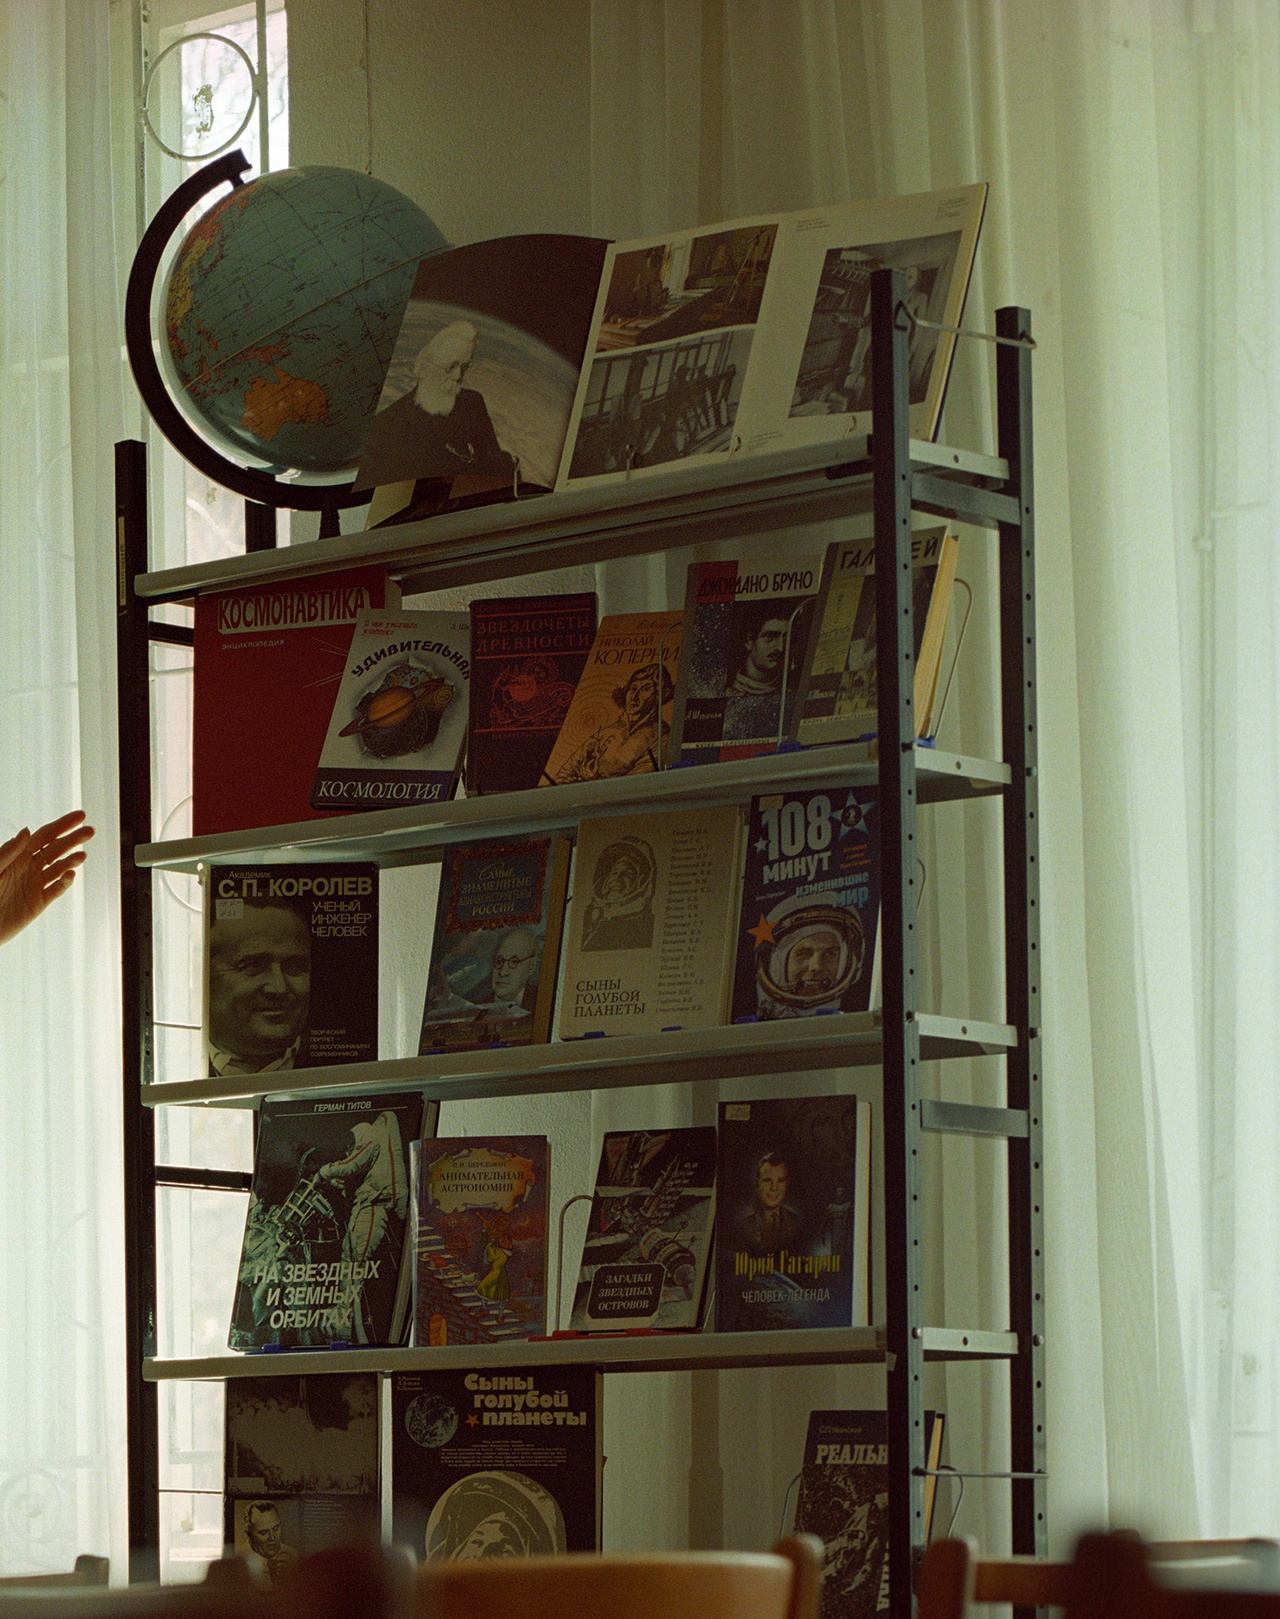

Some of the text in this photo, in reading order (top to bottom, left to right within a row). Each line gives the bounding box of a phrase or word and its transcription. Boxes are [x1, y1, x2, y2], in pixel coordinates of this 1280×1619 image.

[840, 537, 939, 569] ГАЛЕЙ
[698, 571, 814, 597] ДЖОРДАНО БРУНО
[218, 587, 366, 630] КОСМОНАВТИКА
[476, 616, 590, 634] ЗВЕЗДОЧЕТЫ
[221, 638, 285, 650] ЭНЦИКЛОПЕДИЯ
[476, 634, 590, 652] ДРЕВНОСТИ
[598, 635, 654, 648] НИКОЛАЙ
[594, 646, 680, 665] КОПЕРНИ
[317, 780, 443, 800] КОСМОЛОГИЯ
[761, 795, 832, 861] 108
[228, 870, 272, 880] Академик
[269, 877, 373, 897] КОРОЛЕВ
[461, 876, 532, 894] ЗНАМЕНИТЫЕ
[796, 872, 869, 898] изменившие
[312, 899, 361, 912] УЧЕНЫЙ
[472, 901, 516, 916] РОССИИ
[311, 913, 372, 925] ИНЖЕНЕР
[311, 926, 368, 938] ЧЕЛОВЕК
[576, 978, 621, 992] СЫНЫ
[575, 988, 641, 1005] ГОЛУБОЙ
[574, 1003, 646, 1018] ПЛАНЕТЫ
[313, 1100, 372, 1112] ГЕРМАН ТИТОВ
[441, 1183, 514, 1193] АСТРОНОМИЯ
[253, 1260, 382, 1285] НА ЗВЕЗДНЫХ
[734, 1250, 841, 1281] Юрий Гагарин
[605, 1273, 653, 1284] ЗАГАДКИ
[266, 1285, 363, 1306] И ЗЕМНЫХ
[598, 1286, 654, 1298] ЗВЕЗДНЫХ
[742, 1288, 831, 1304] ЧЕЛОВЕК-ЛЕГЕНДА
[598, 1300, 650, 1311] ОСТРОВОВ
[464, 1373, 535, 1391] Сыны
[474, 1390, 569, 1411] голубой
[483, 1412, 587, 1426] планеты
[815, 1443, 889, 1465] РЕАЛЬН
